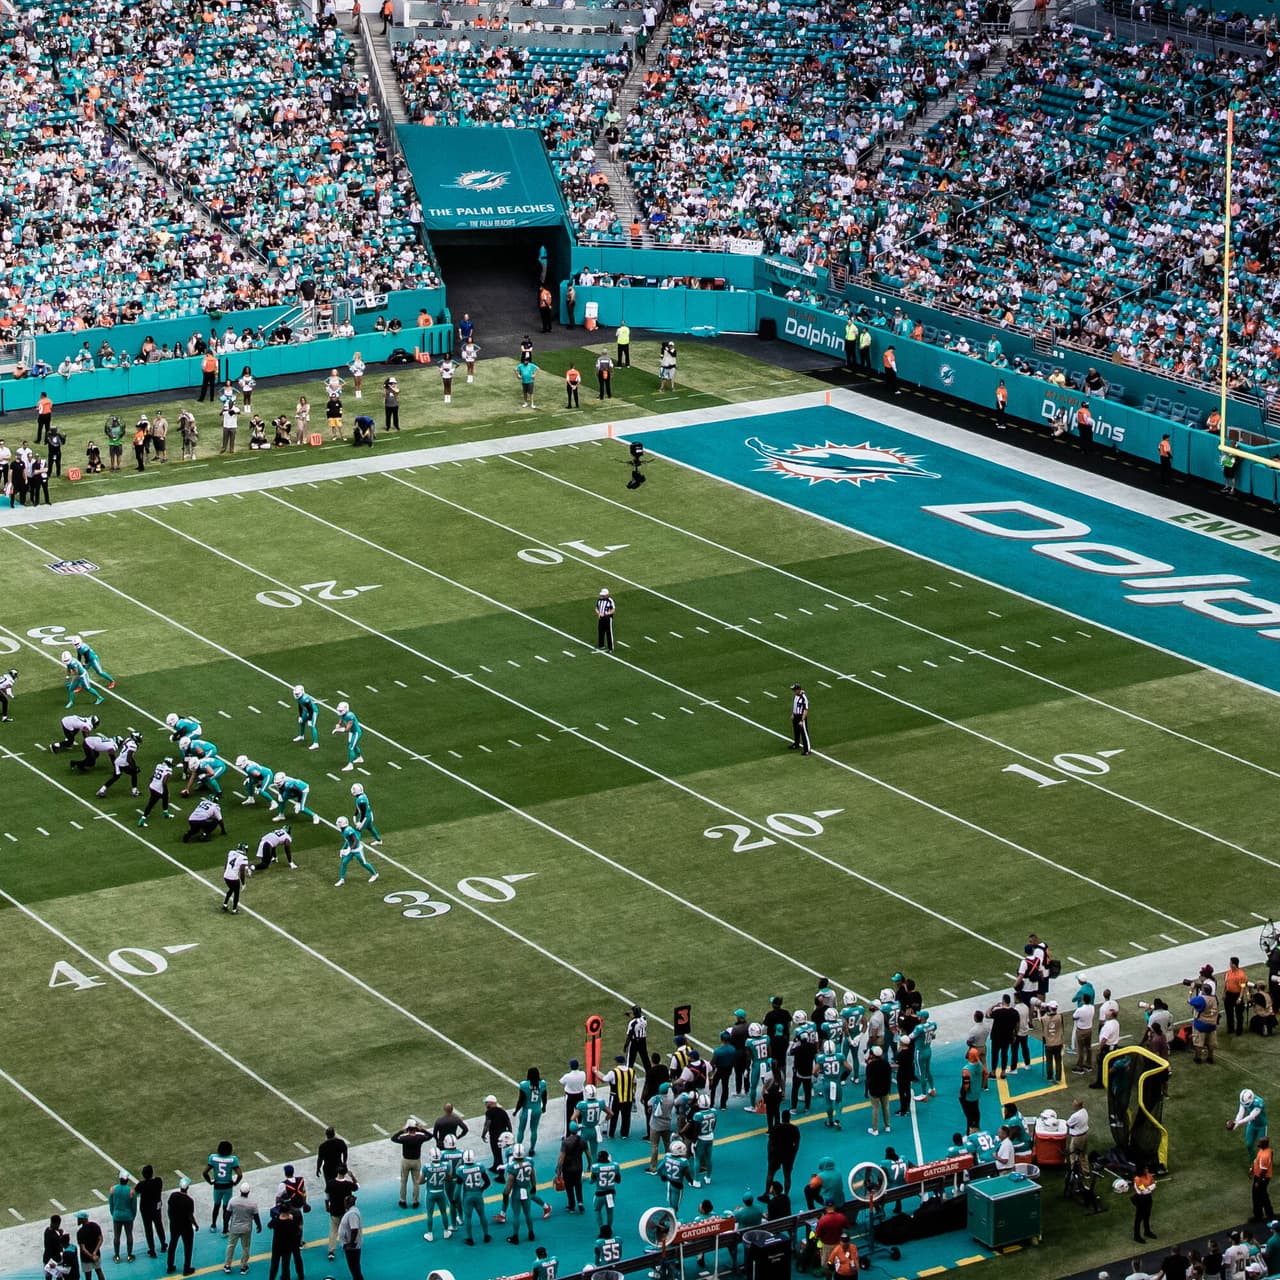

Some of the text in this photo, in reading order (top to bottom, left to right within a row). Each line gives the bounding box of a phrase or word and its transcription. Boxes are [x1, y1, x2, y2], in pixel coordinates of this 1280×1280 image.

[428, 204, 555, 217] THE PALM BEACHES
[785, 318, 845, 351] Dolphin
[1168, 511, 1264, 542] END
[516, 539, 609, 567] 10
[254, 579, 356, 609] 20
[1002, 752, 1111, 789] 10
[703, 811, 825, 853] 20
[382, 875, 518, 918] 30
[48, 947, 169, 991] 40
[823, 1061, 840, 1075] 30
[429, 1172, 446, 1185] 42
[599, 1172, 615, 1186] 52
[924, 1163, 959, 1177] GATORADE
[681, 1224, 720, 1239] GATORADE
[603, 1245, 620, 1261] 55
